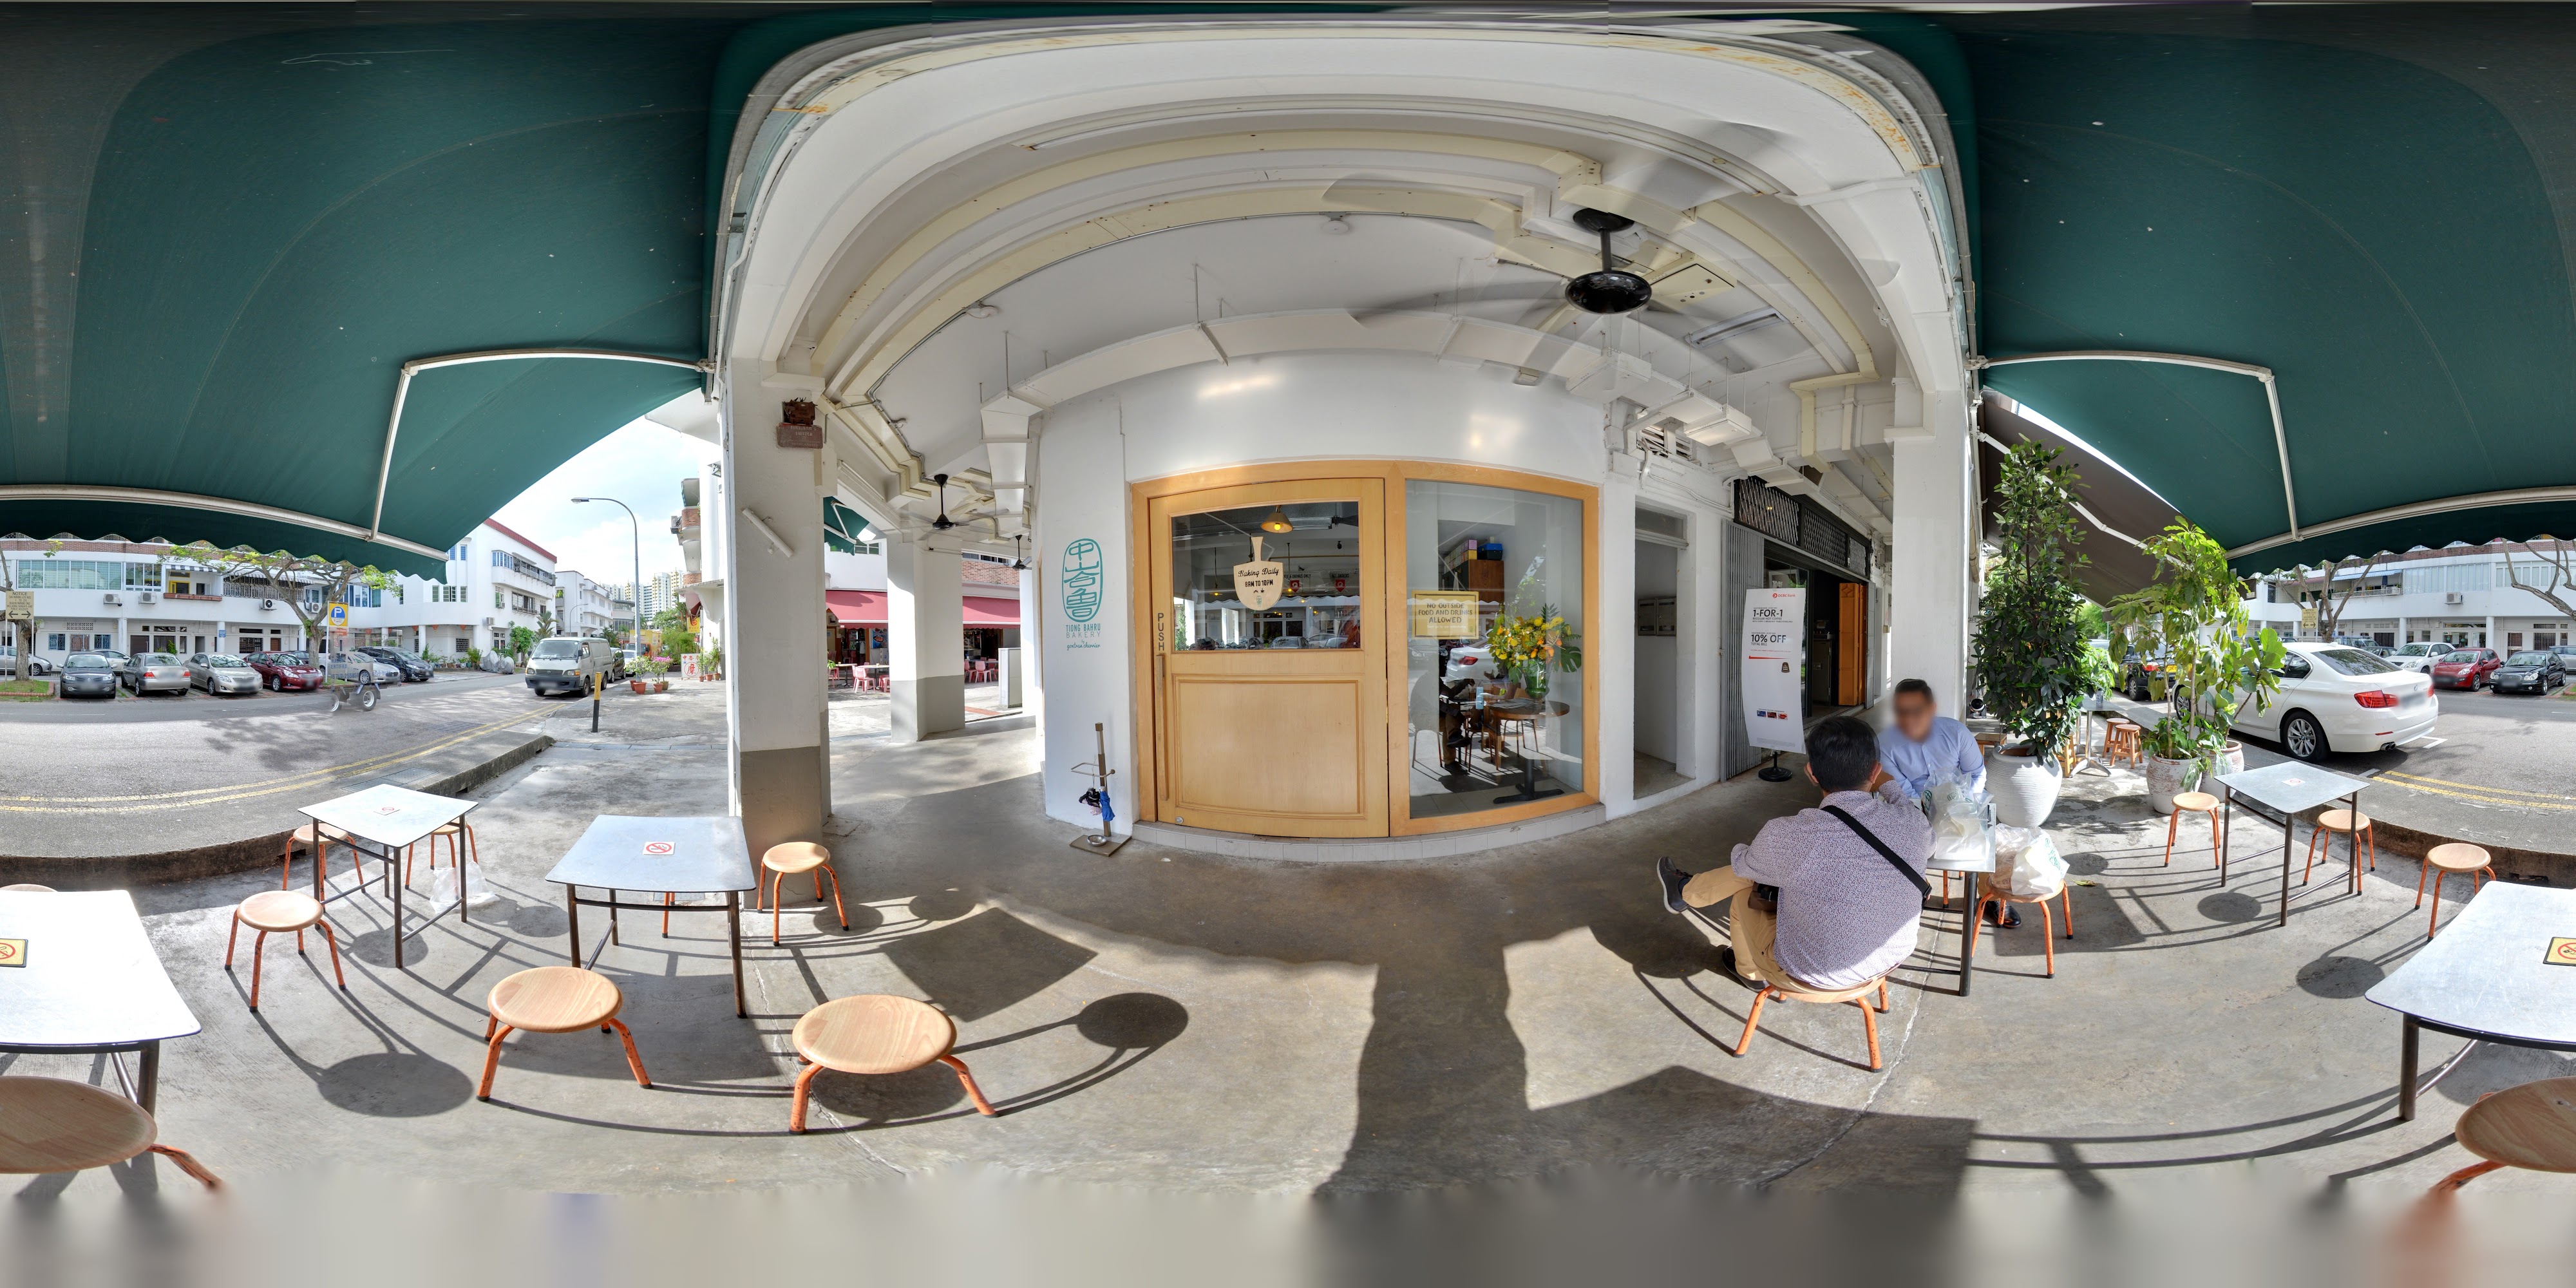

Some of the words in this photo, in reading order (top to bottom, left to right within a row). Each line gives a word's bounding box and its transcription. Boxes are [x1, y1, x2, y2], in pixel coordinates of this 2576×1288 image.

[1238, 570, 1260, 578] Baking
[1262, 567, 1279, 576] Daily
[334, 608, 342, 617] P
